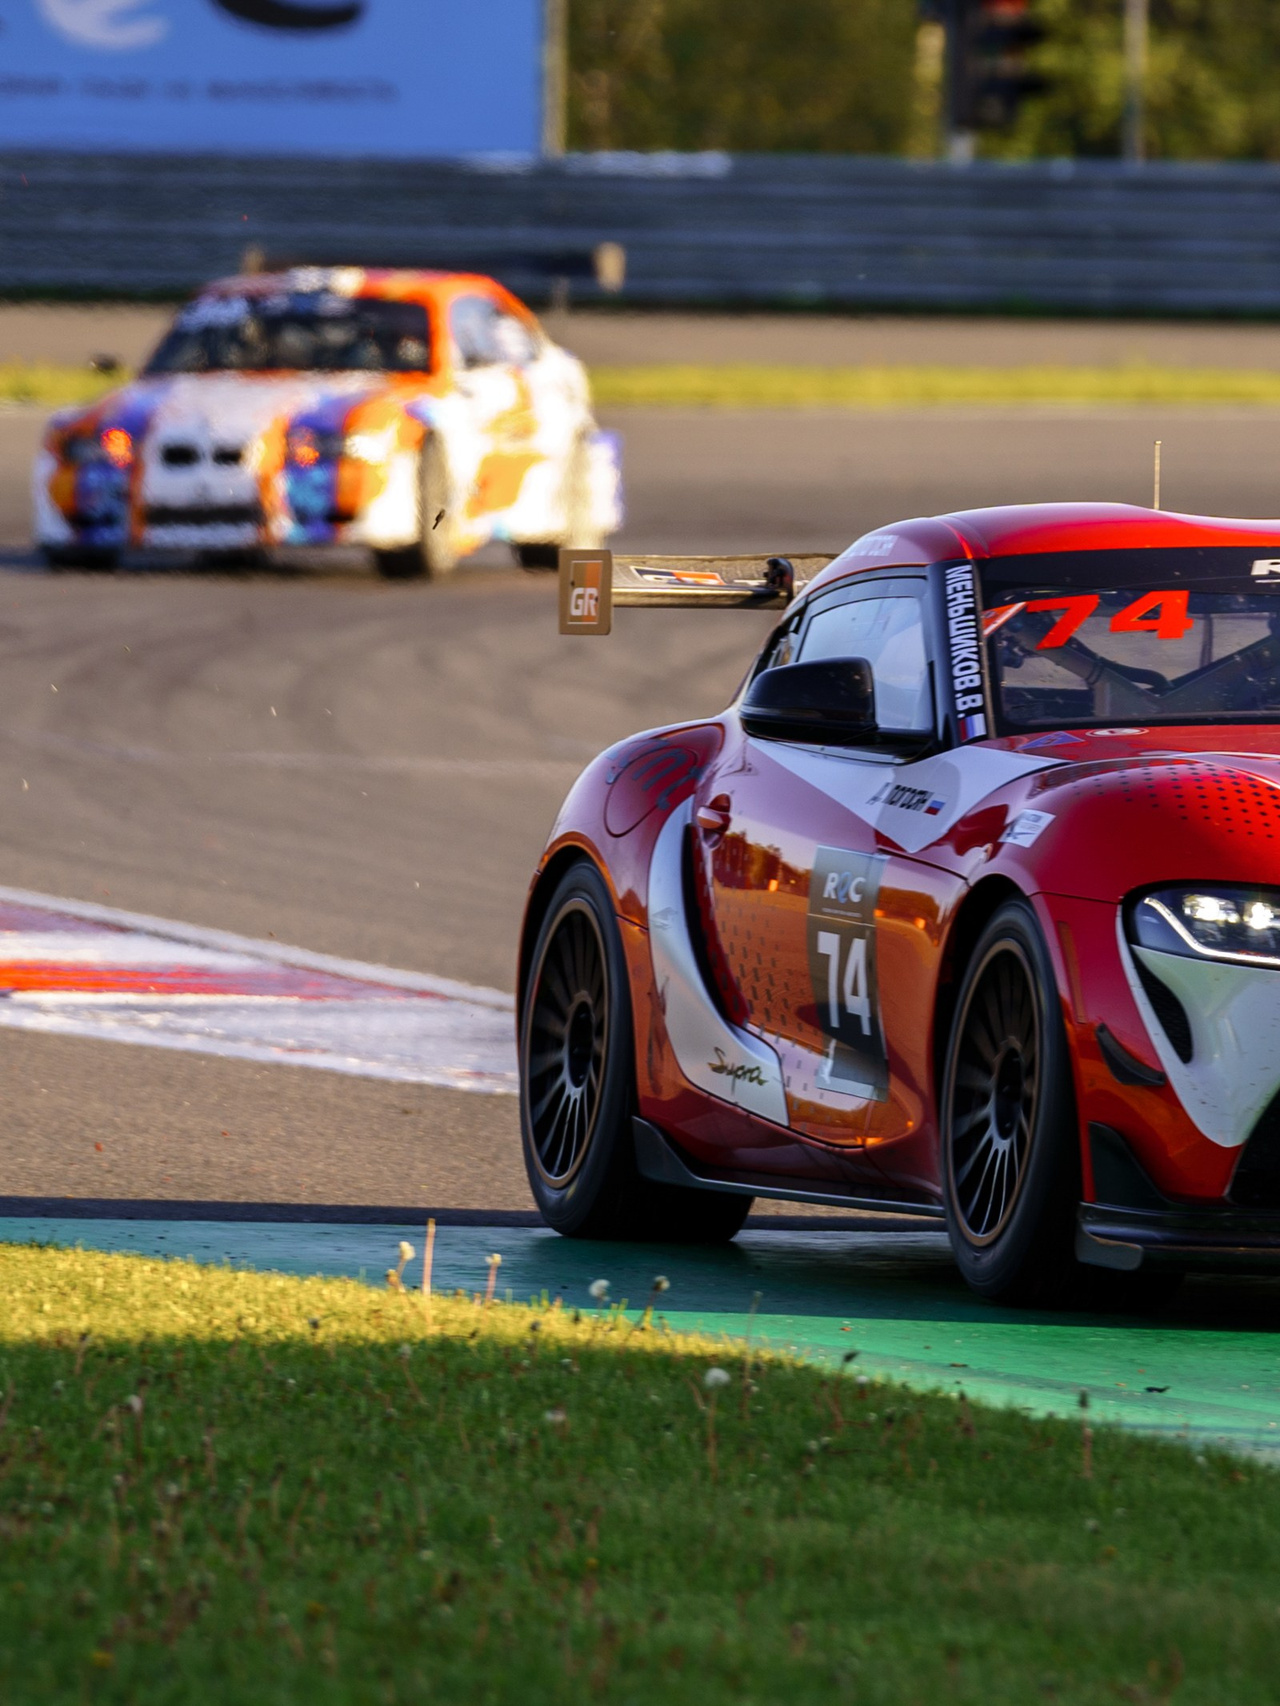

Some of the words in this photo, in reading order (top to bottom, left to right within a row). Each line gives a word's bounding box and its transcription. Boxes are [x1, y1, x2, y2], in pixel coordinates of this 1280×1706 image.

[570, 587, 598, 616] GR
[1026, 590, 1194, 650] 74
[816, 931, 871, 1036] 74
[706, 1046, 769, 1096] Supra
